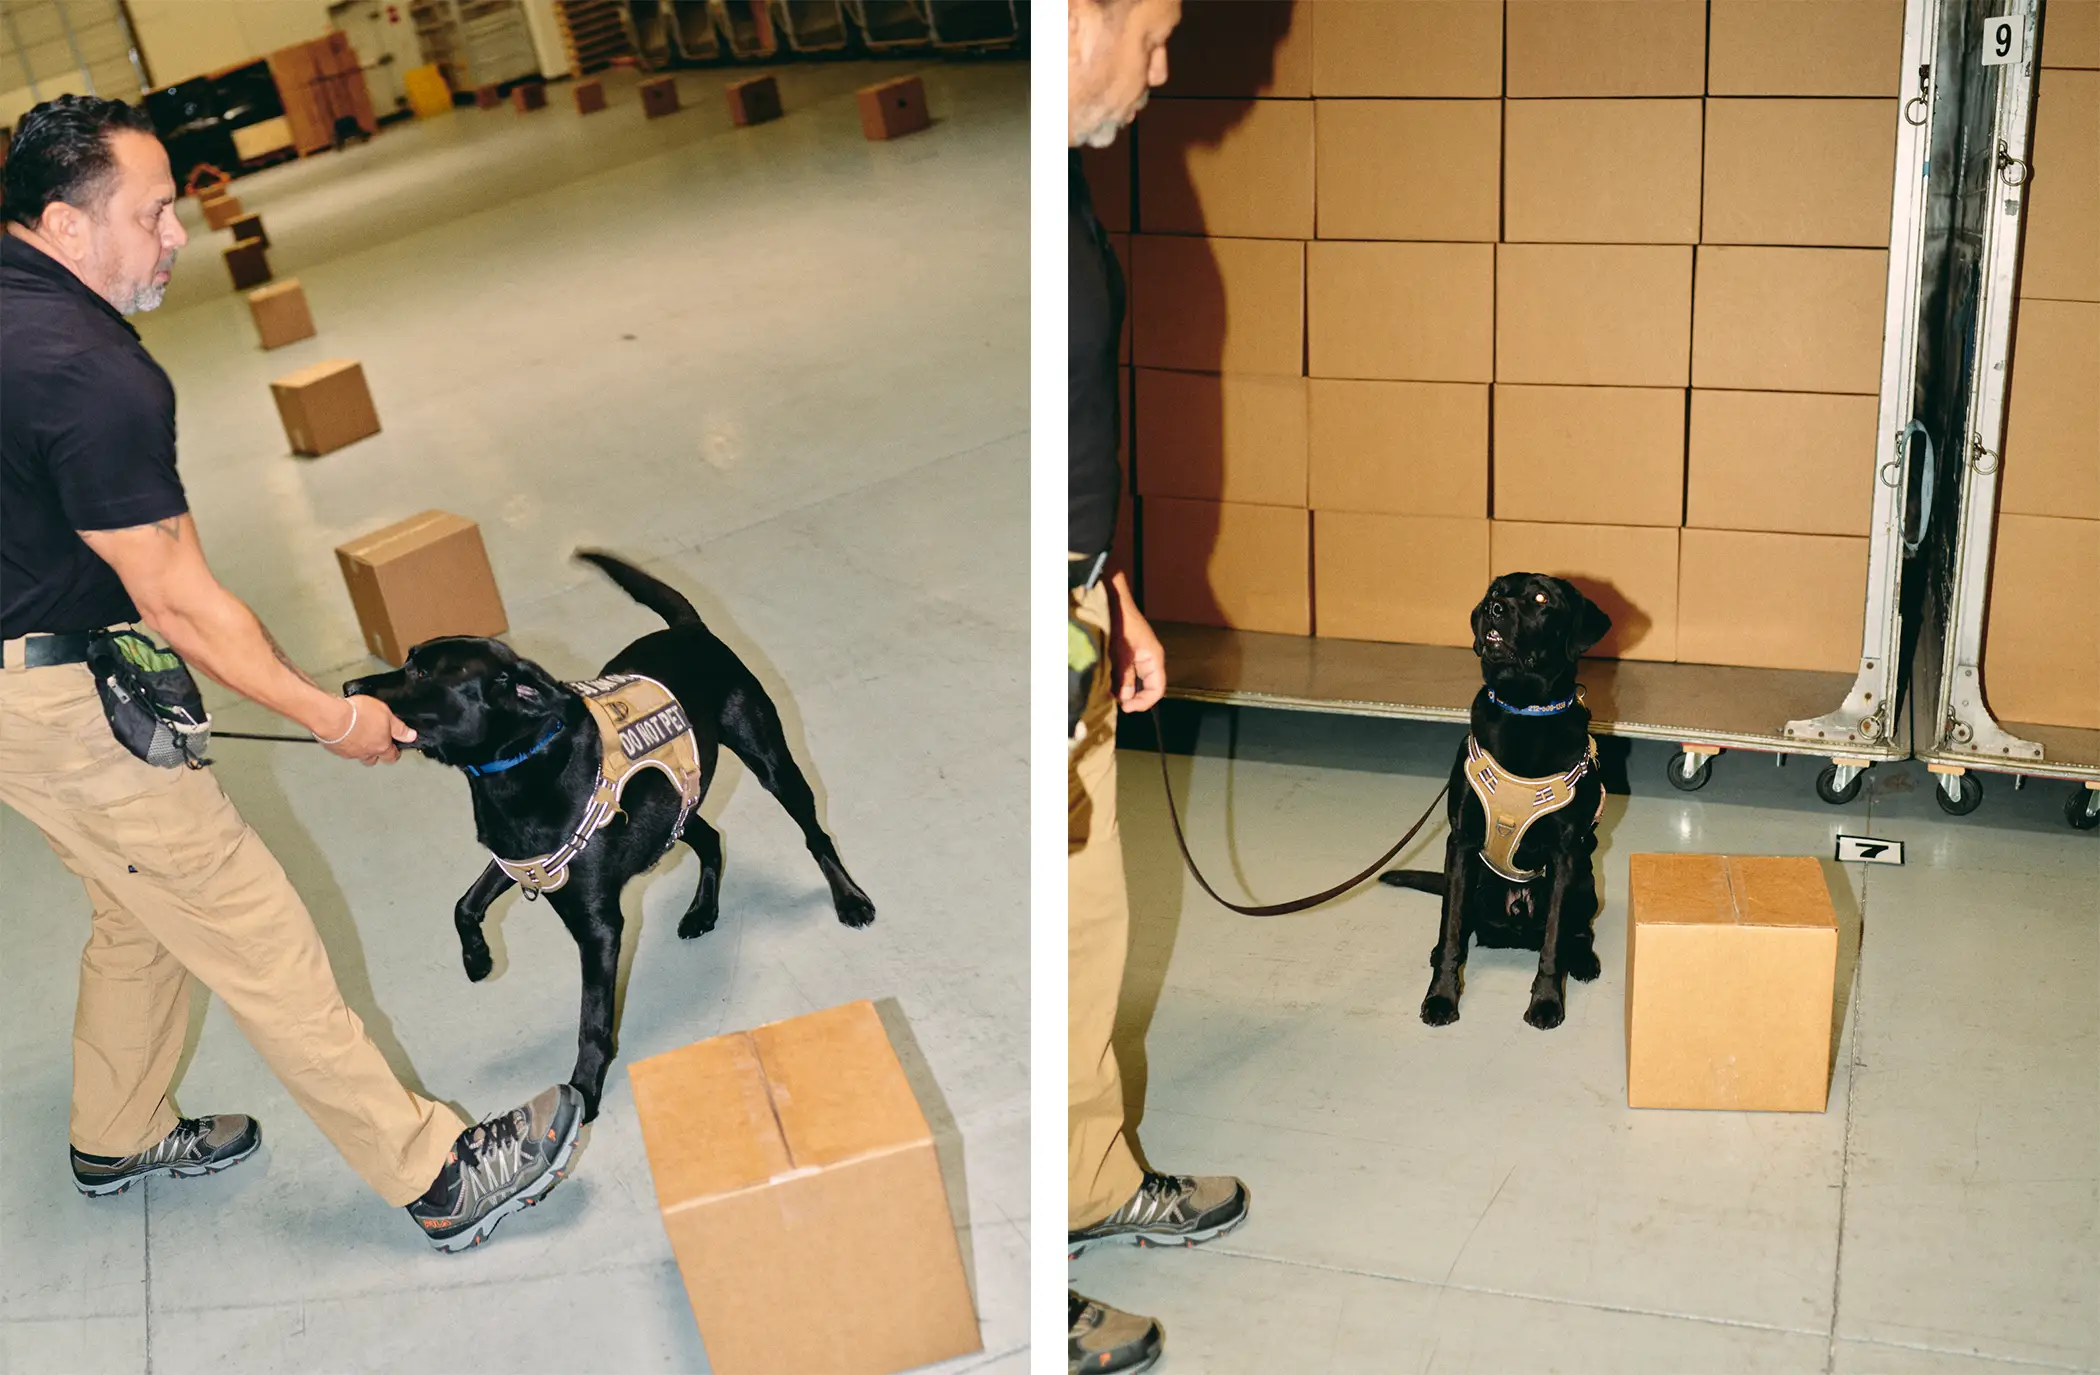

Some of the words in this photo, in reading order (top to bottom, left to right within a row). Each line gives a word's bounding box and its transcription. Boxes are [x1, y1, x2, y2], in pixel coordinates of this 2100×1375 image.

[1995, 23, 2012, 57] 9
[619, 729, 643, 756] DO
[635, 715, 666, 748] NOT
[657, 705, 686, 736] PET
[1855, 842, 1889, 859] 7
